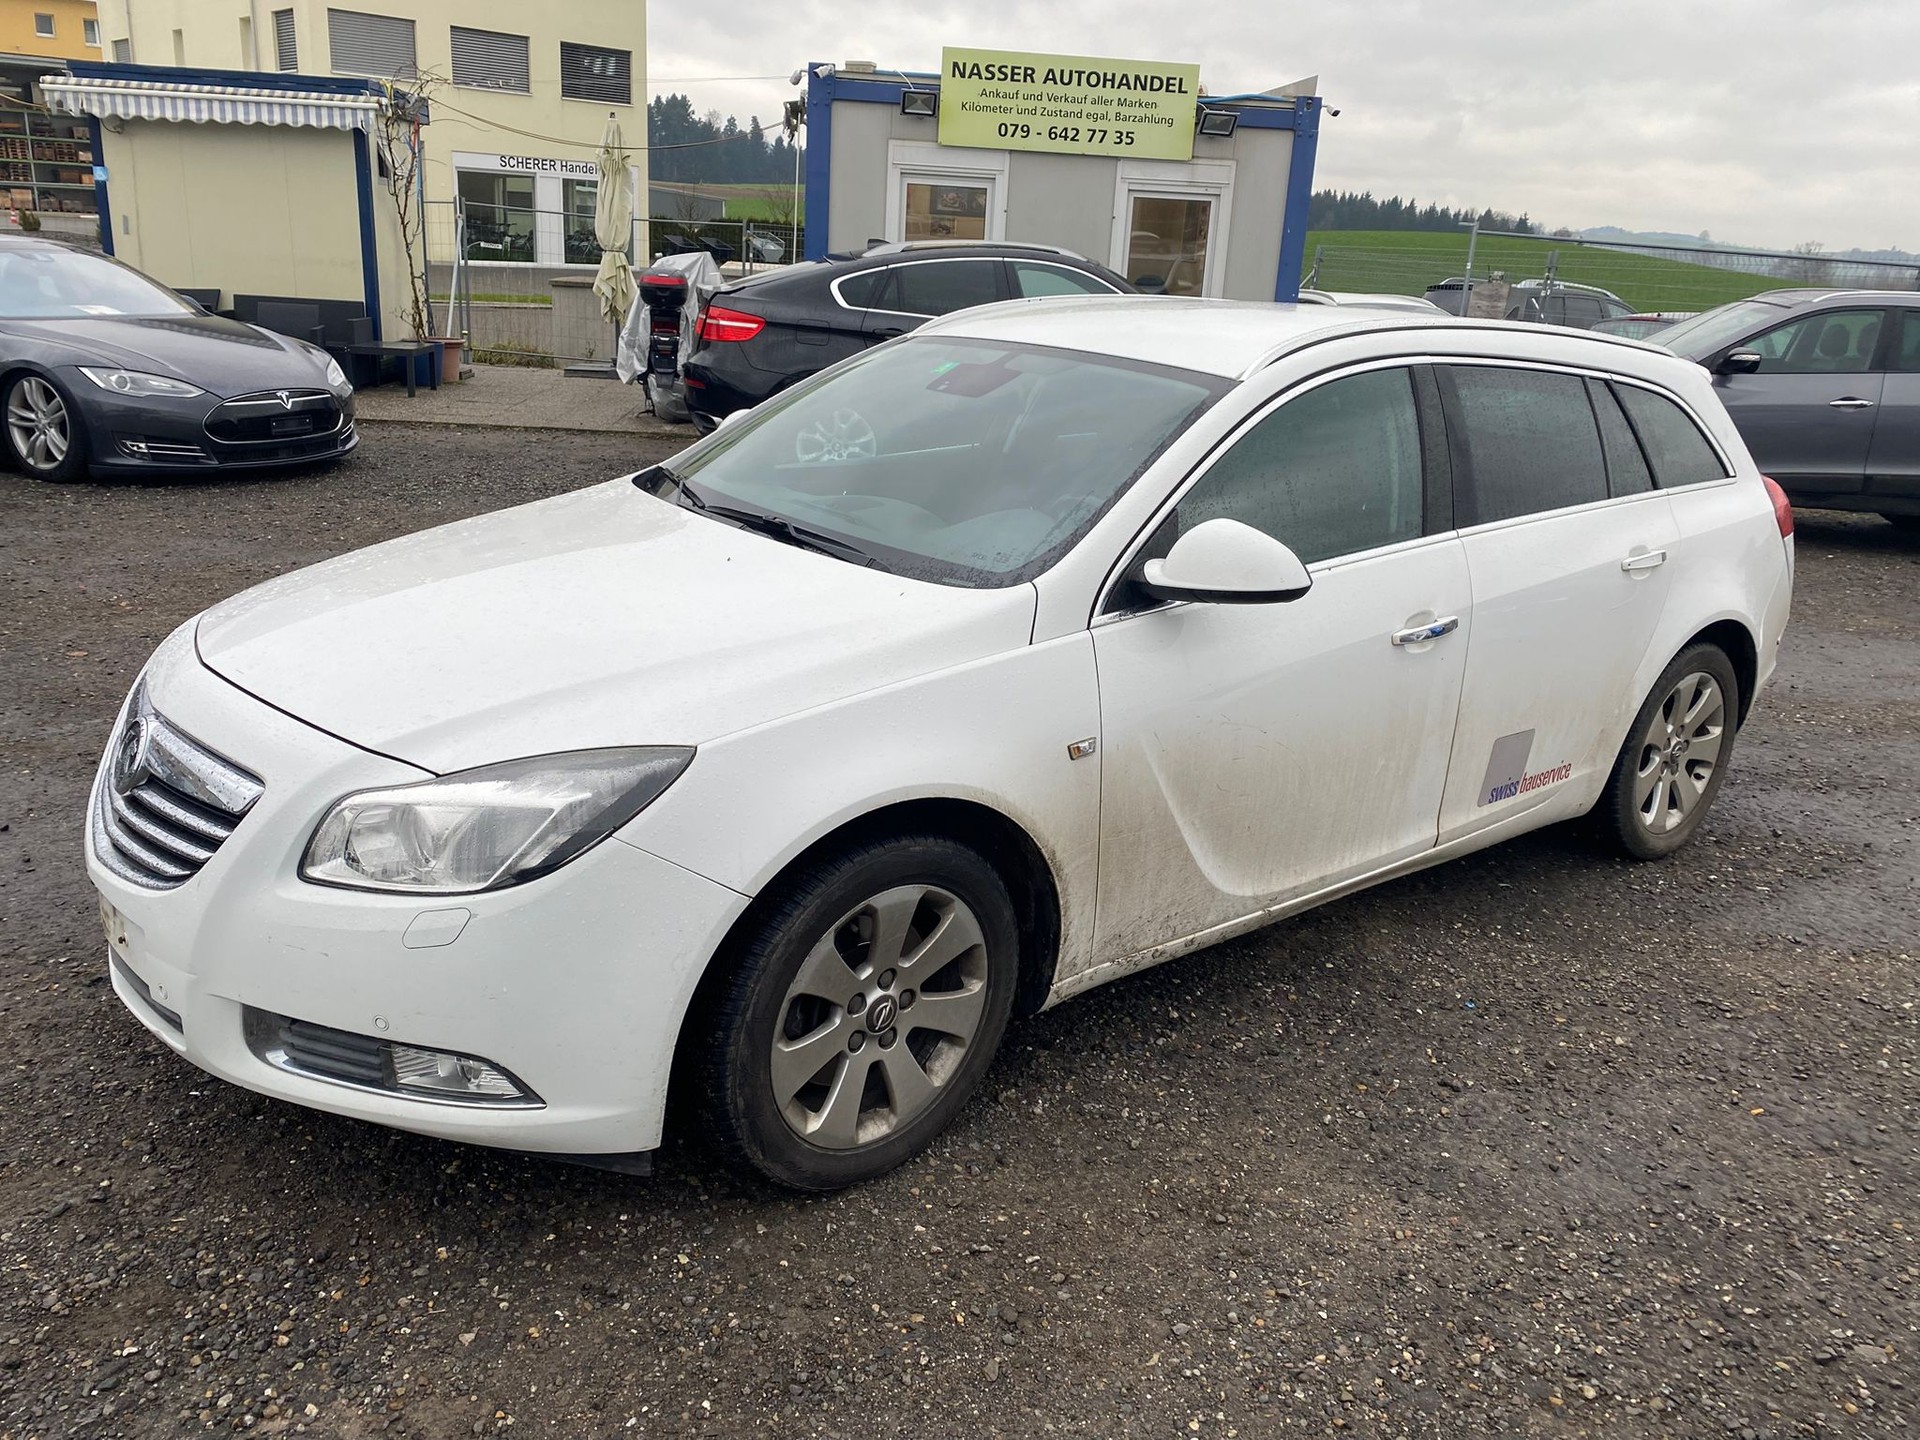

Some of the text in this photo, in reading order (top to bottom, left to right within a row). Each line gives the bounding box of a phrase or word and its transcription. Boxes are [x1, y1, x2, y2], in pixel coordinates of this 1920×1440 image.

[951, 61, 1188, 94] NASSER AUTOHANDEL
[980, 88, 1157, 110] Ankauf und Verkauf aller Marken
[961, 101, 1174, 128] Kilometer und Zustand egal, Barzahlung
[998, 122, 1030, 139] 079
[1048, 125, 1080, 143] 642
[1086, 129, 1108, 144] 77
[1113, 129, 1135, 146] 35
[499, 155, 556, 172] SCHERER
[1488, 760, 1572, 803] swiss bauservice
